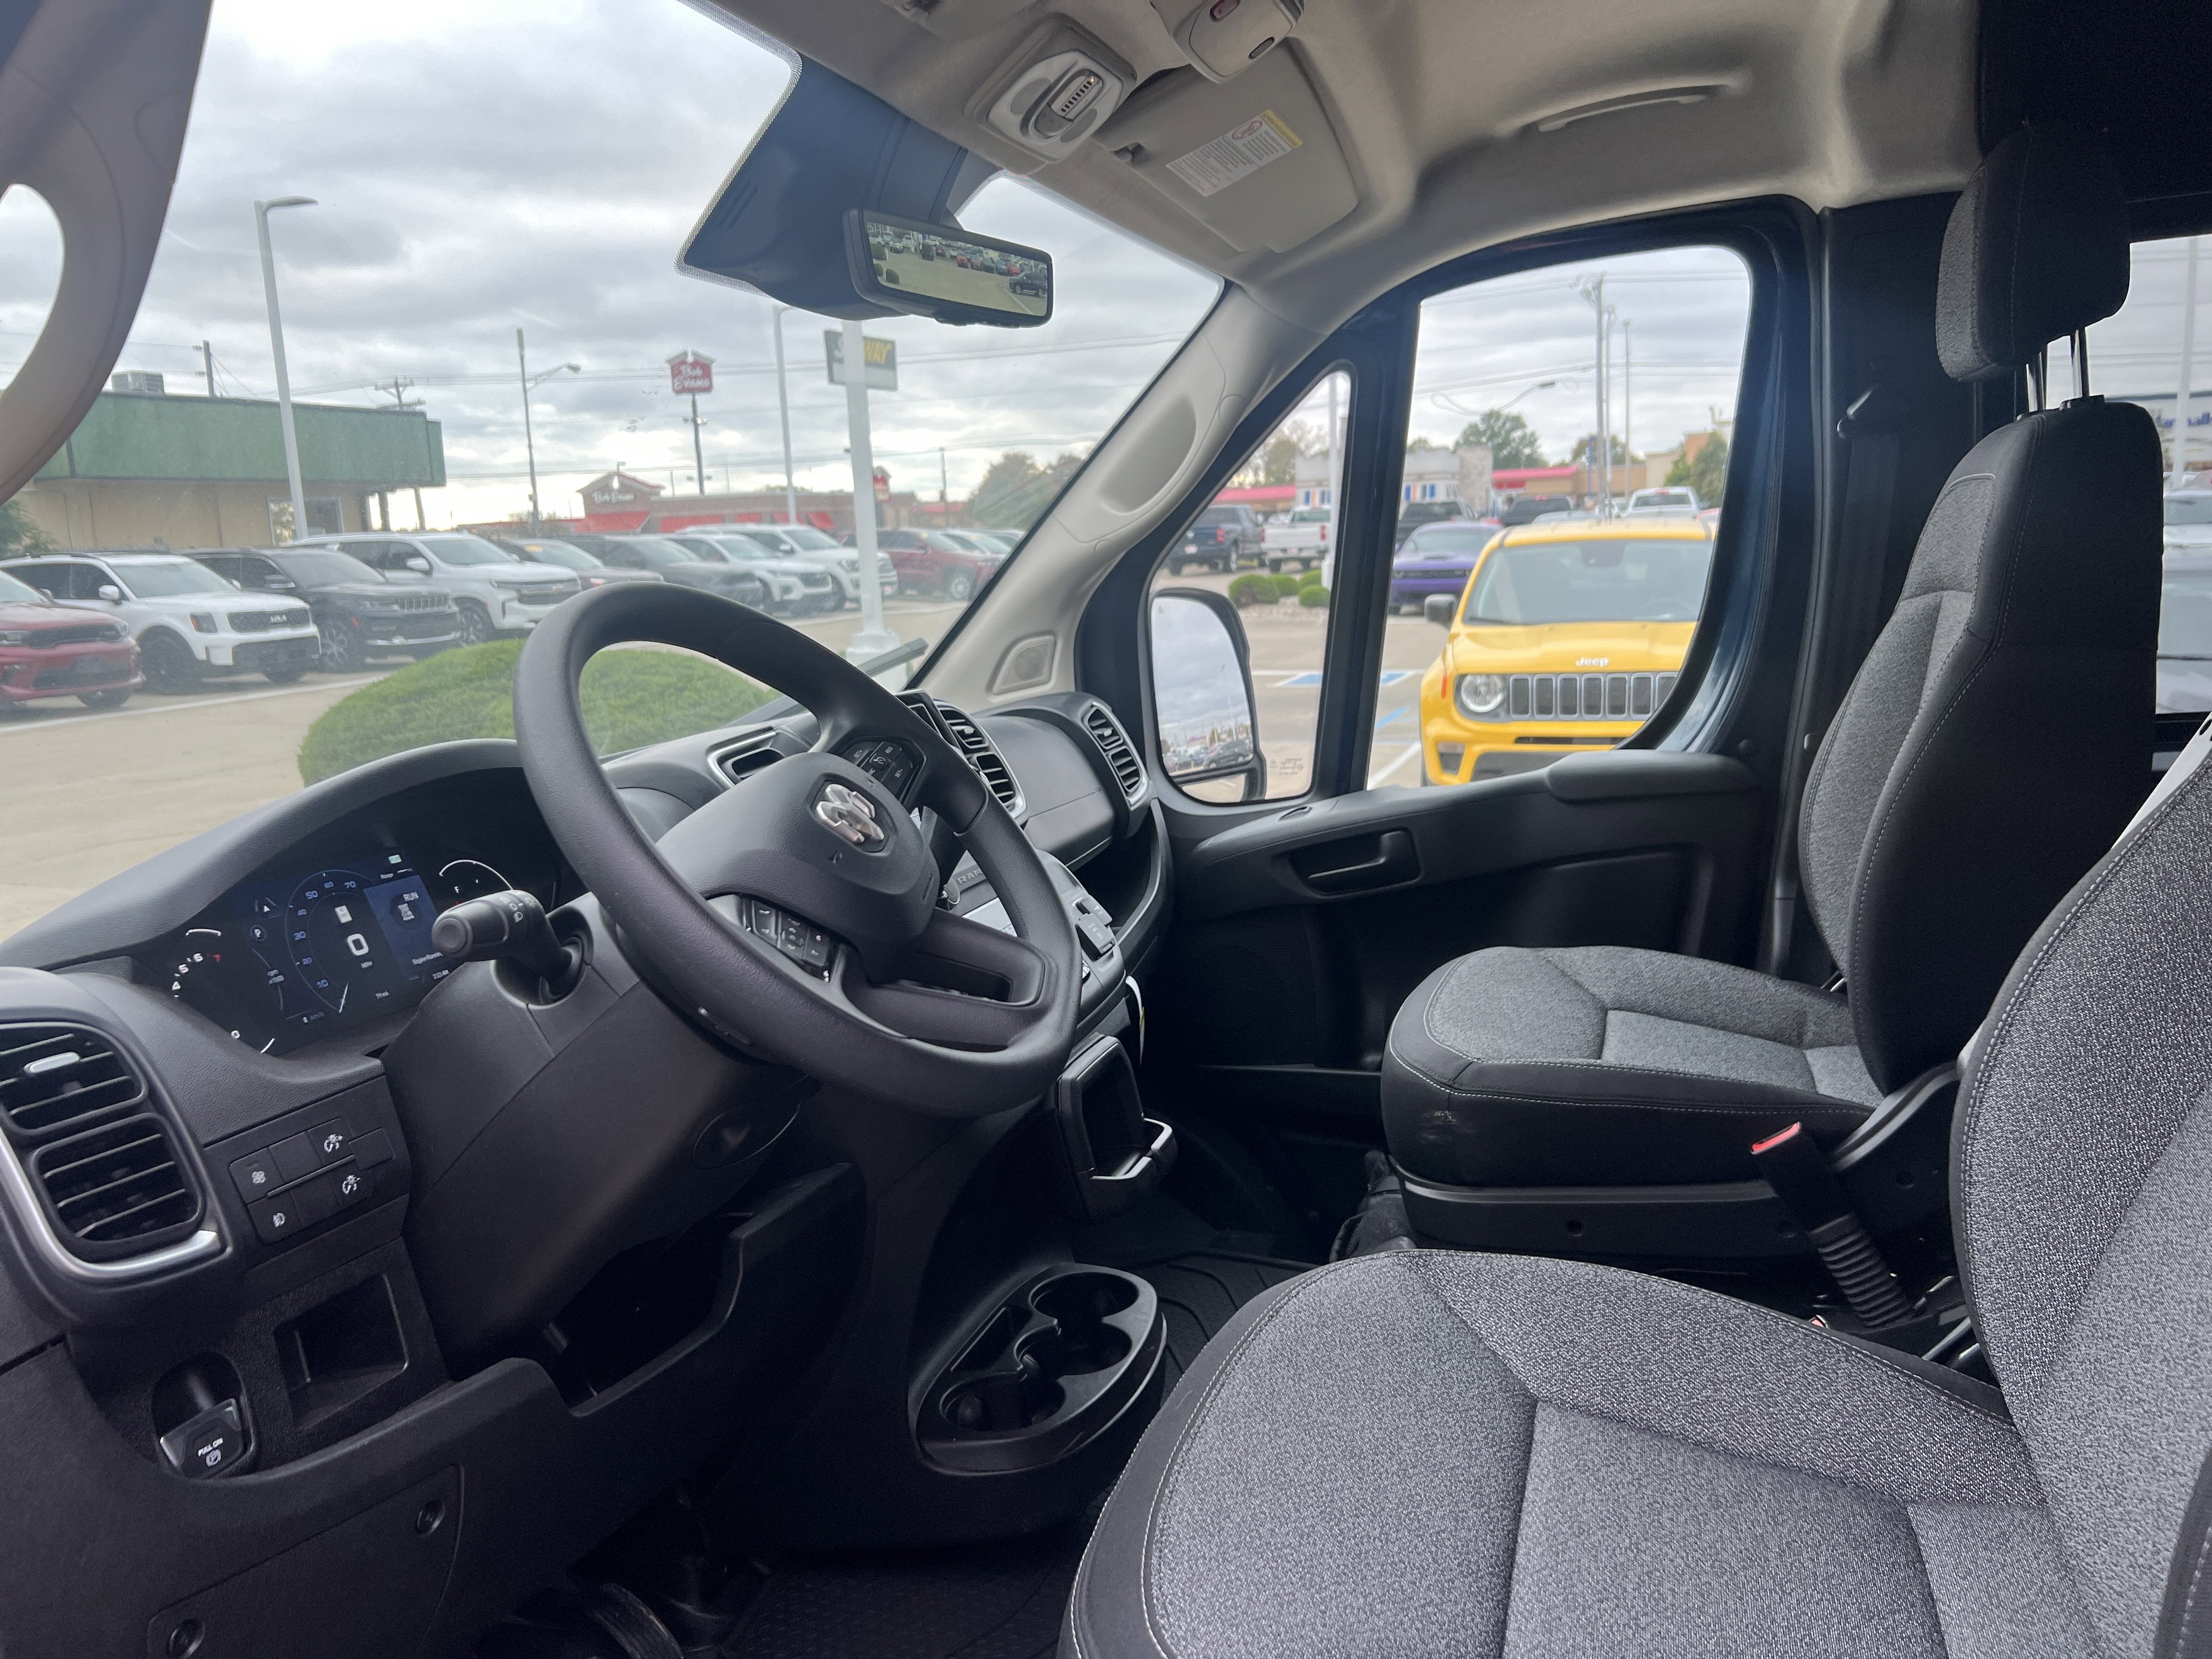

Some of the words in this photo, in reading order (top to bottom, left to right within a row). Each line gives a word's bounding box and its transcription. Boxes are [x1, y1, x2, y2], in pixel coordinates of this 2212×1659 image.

[680, 364, 702, 377] Bob
[592, 490, 611, 504] Bob
[1575, 656, 1609, 668] Jeep
[957, 868, 984, 884] RAM
[344, 880, 356, 889] 70
[305, 890, 318, 899] 50
[403, 891, 419, 902] RUN
[346, 933, 369, 956] 0
[193, 952, 204, 963] 6
[198, 1444, 213, 1457] PULL
[212, 1437, 223, 1448] ON
